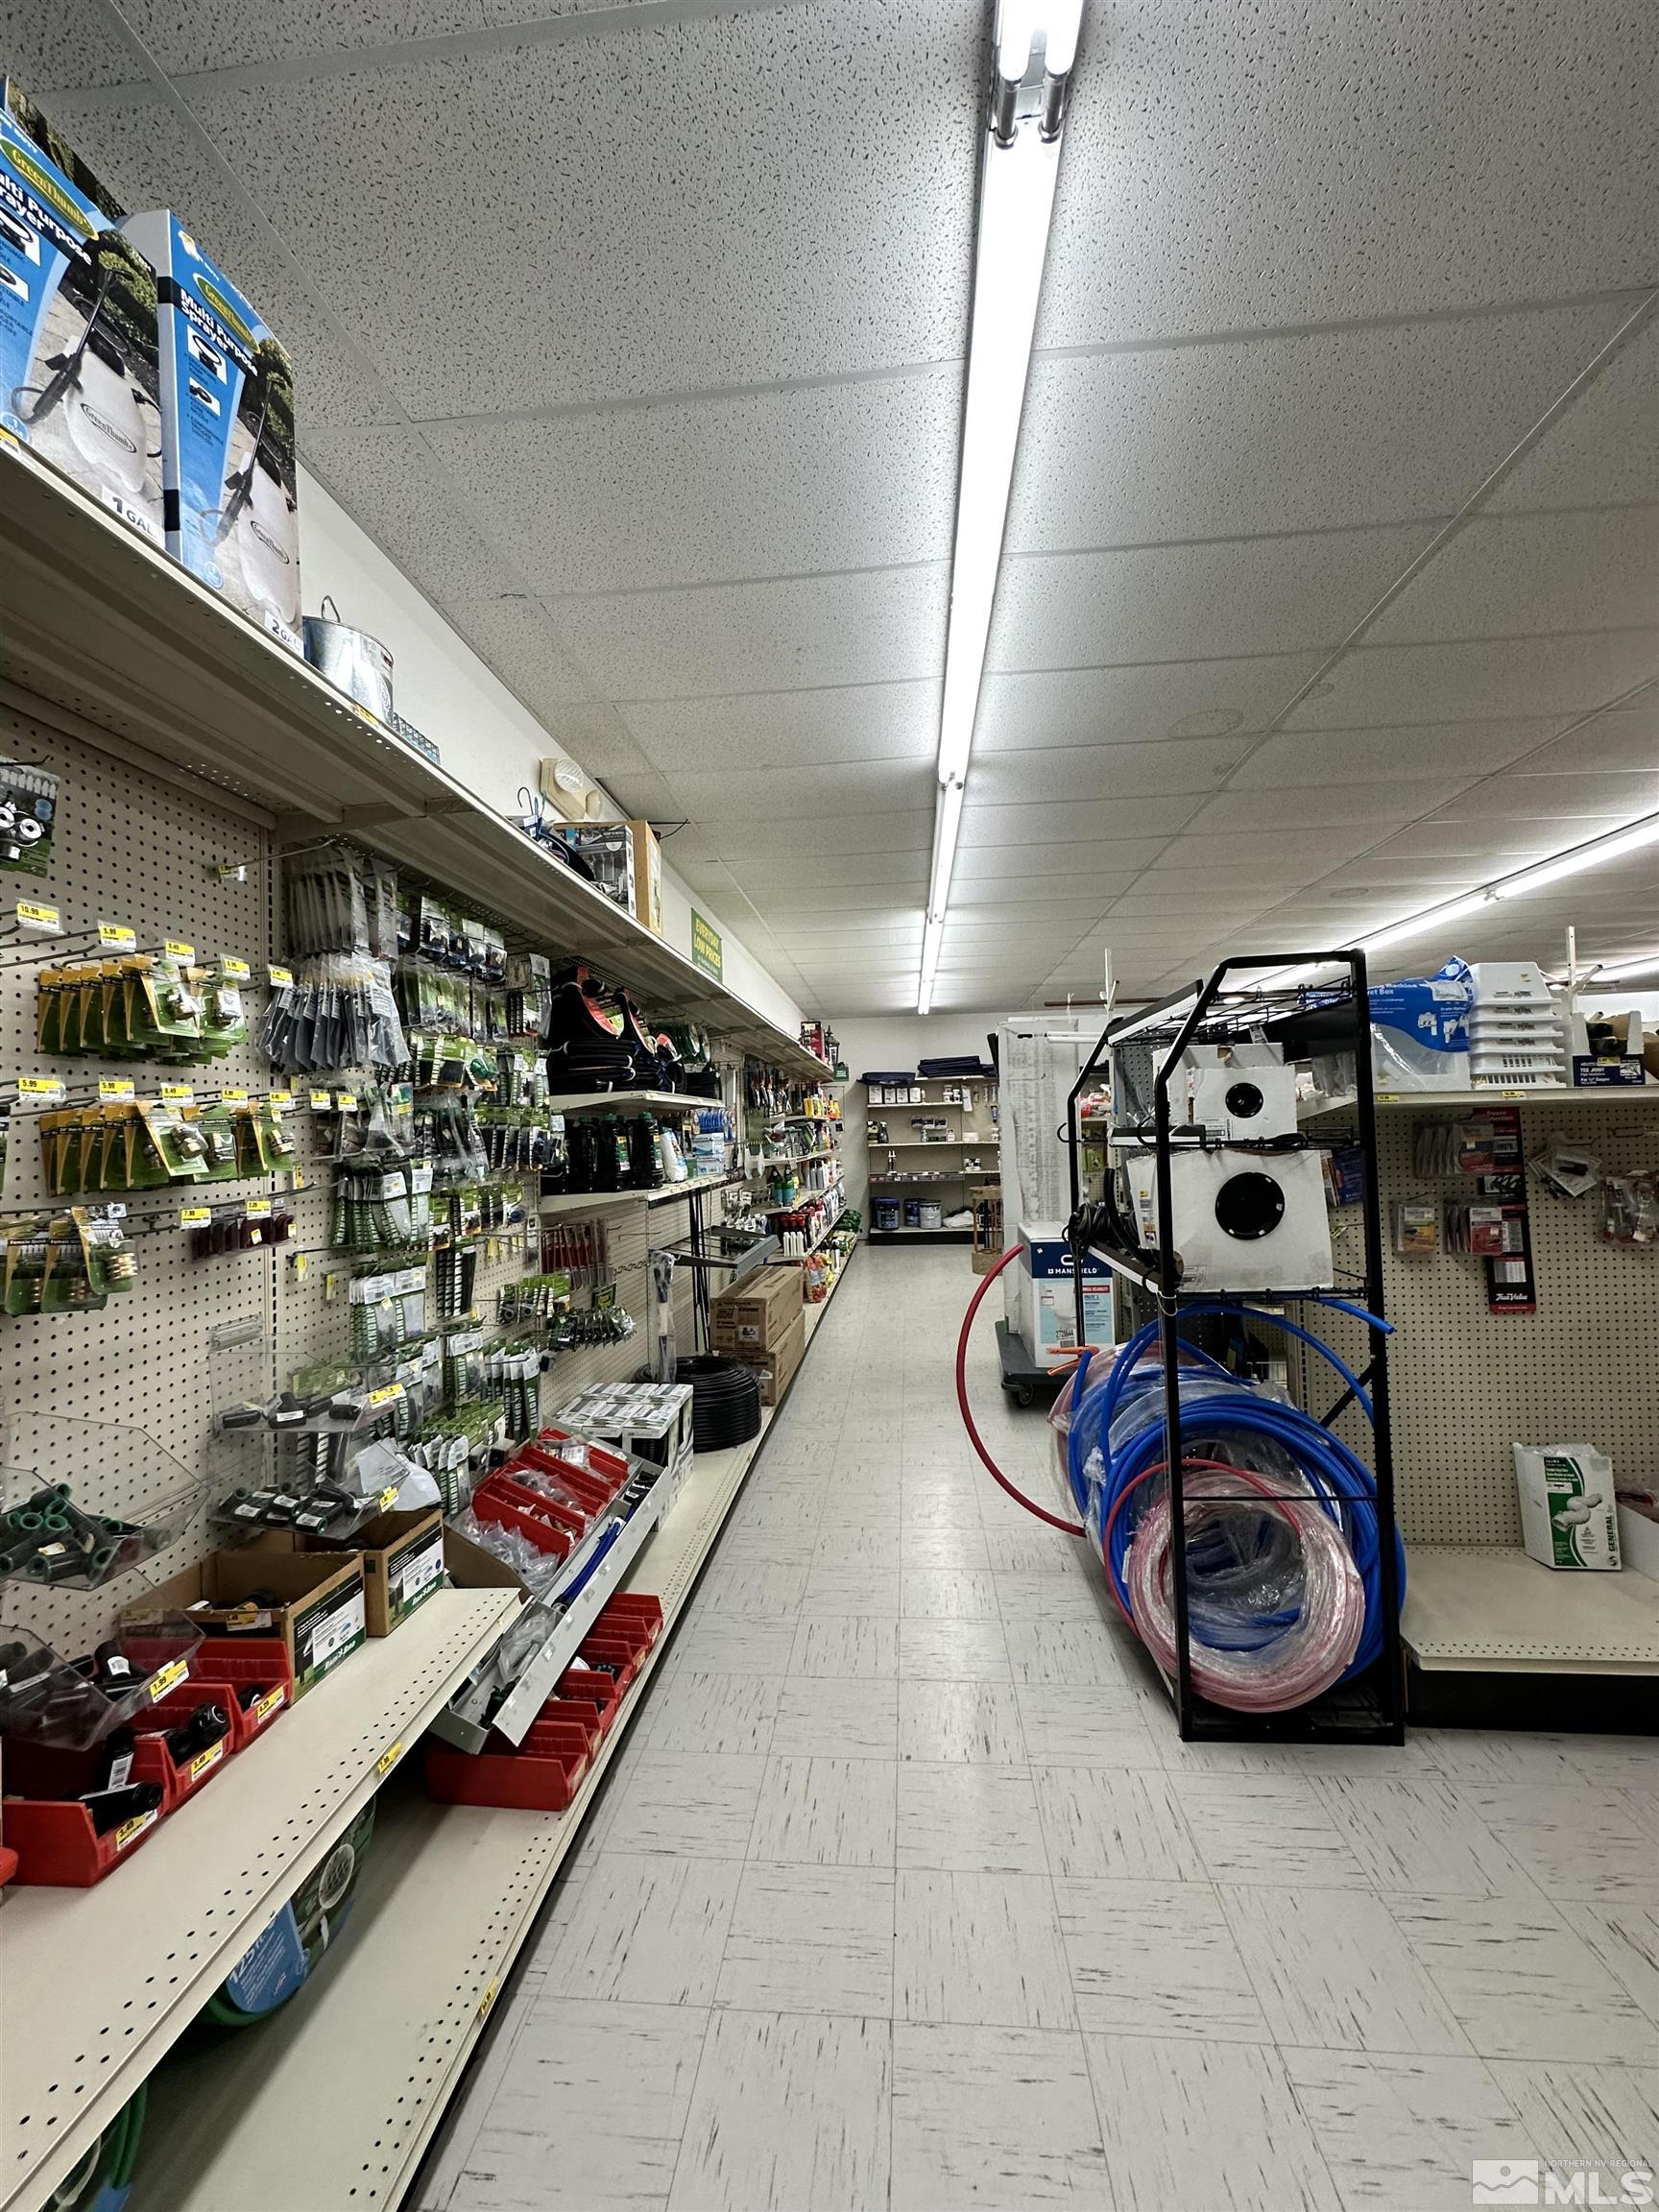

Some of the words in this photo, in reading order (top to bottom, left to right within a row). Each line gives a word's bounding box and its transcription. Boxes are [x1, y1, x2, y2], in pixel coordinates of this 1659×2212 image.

[0, 185, 44, 230] rayer
[28, 196, 92, 266] Purpose
[180, 301, 228, 352] Sprayer
[180, 288, 214, 328] Multi
[217, 321, 258, 376] Purpose
[112, 497, 124, 515] 1
[271, 618, 280, 633] 2
[22, 1079, 37, 1088] 5.99
[398, 1398, 409, 1436] RAINDRI
[1605, 1515, 1615, 1551] GENERAL
[153, 1675, 167, 1691] 1.99
